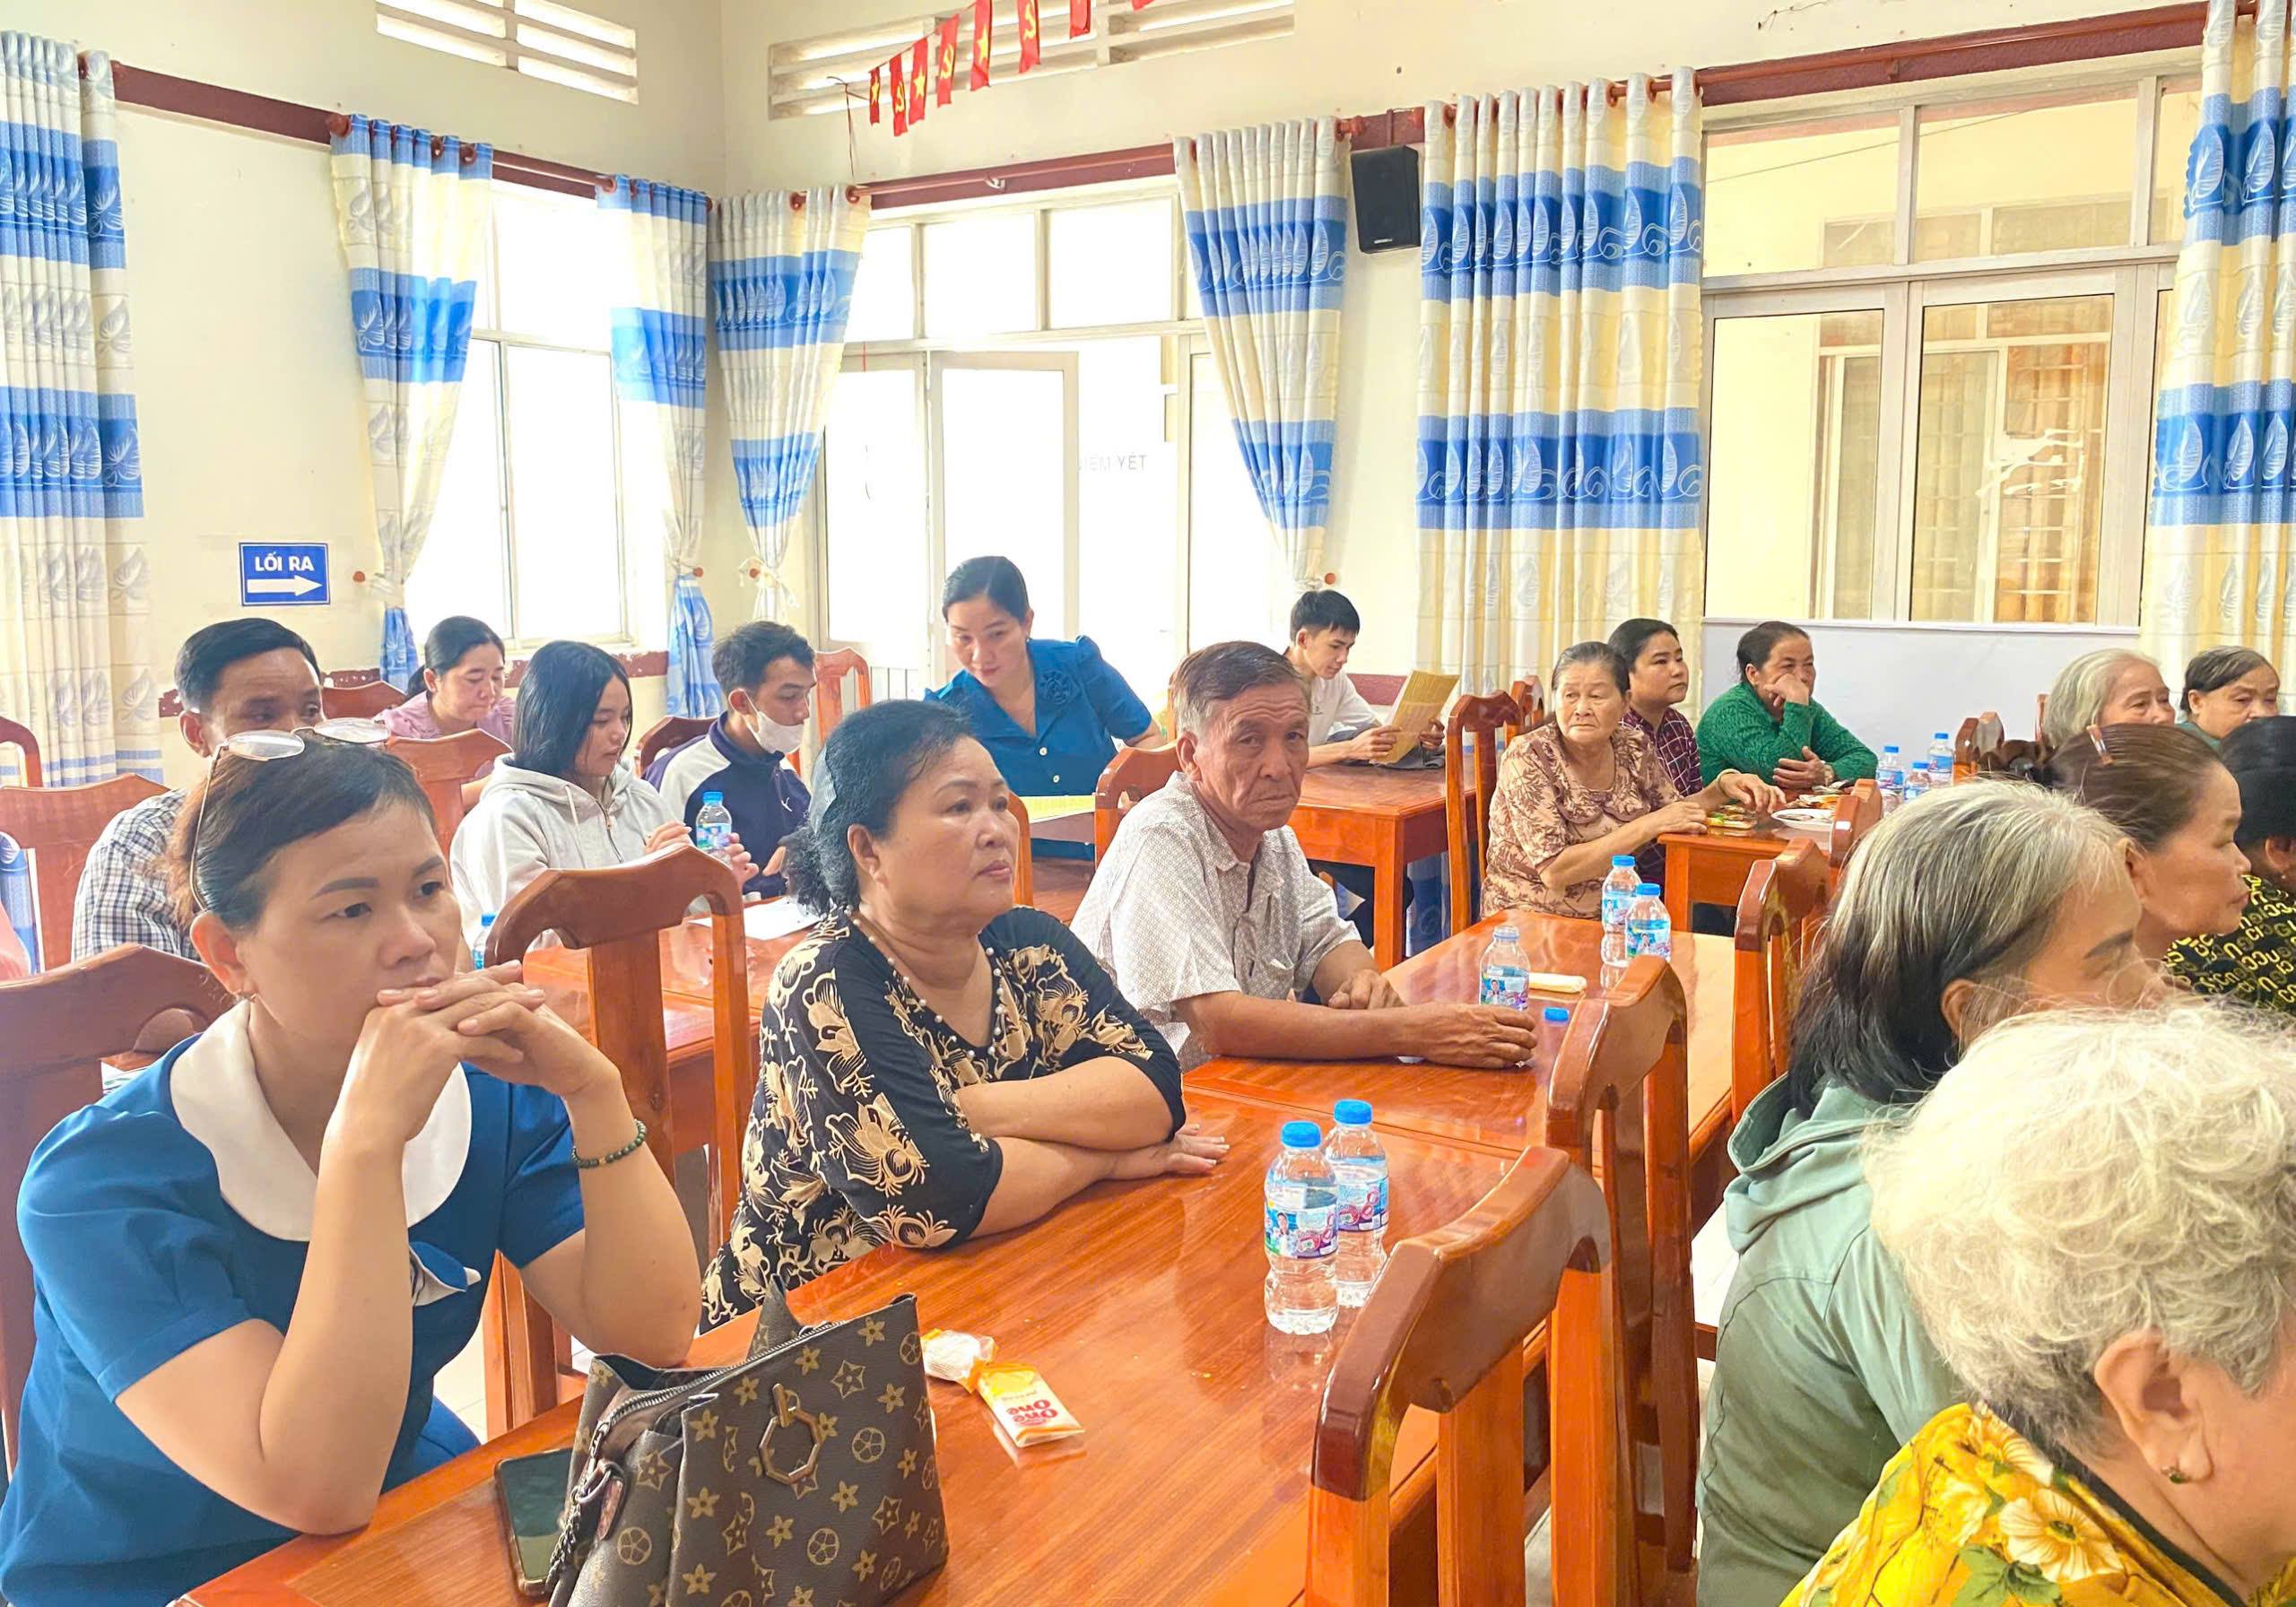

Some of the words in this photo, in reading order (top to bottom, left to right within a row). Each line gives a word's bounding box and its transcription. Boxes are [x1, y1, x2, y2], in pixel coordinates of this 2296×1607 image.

[255, 551, 283, 571] LỐI
[288, 555, 315, 571] RA
[1005, 1399, 1050, 1415] One
[1013, 1409, 1058, 1422] One
